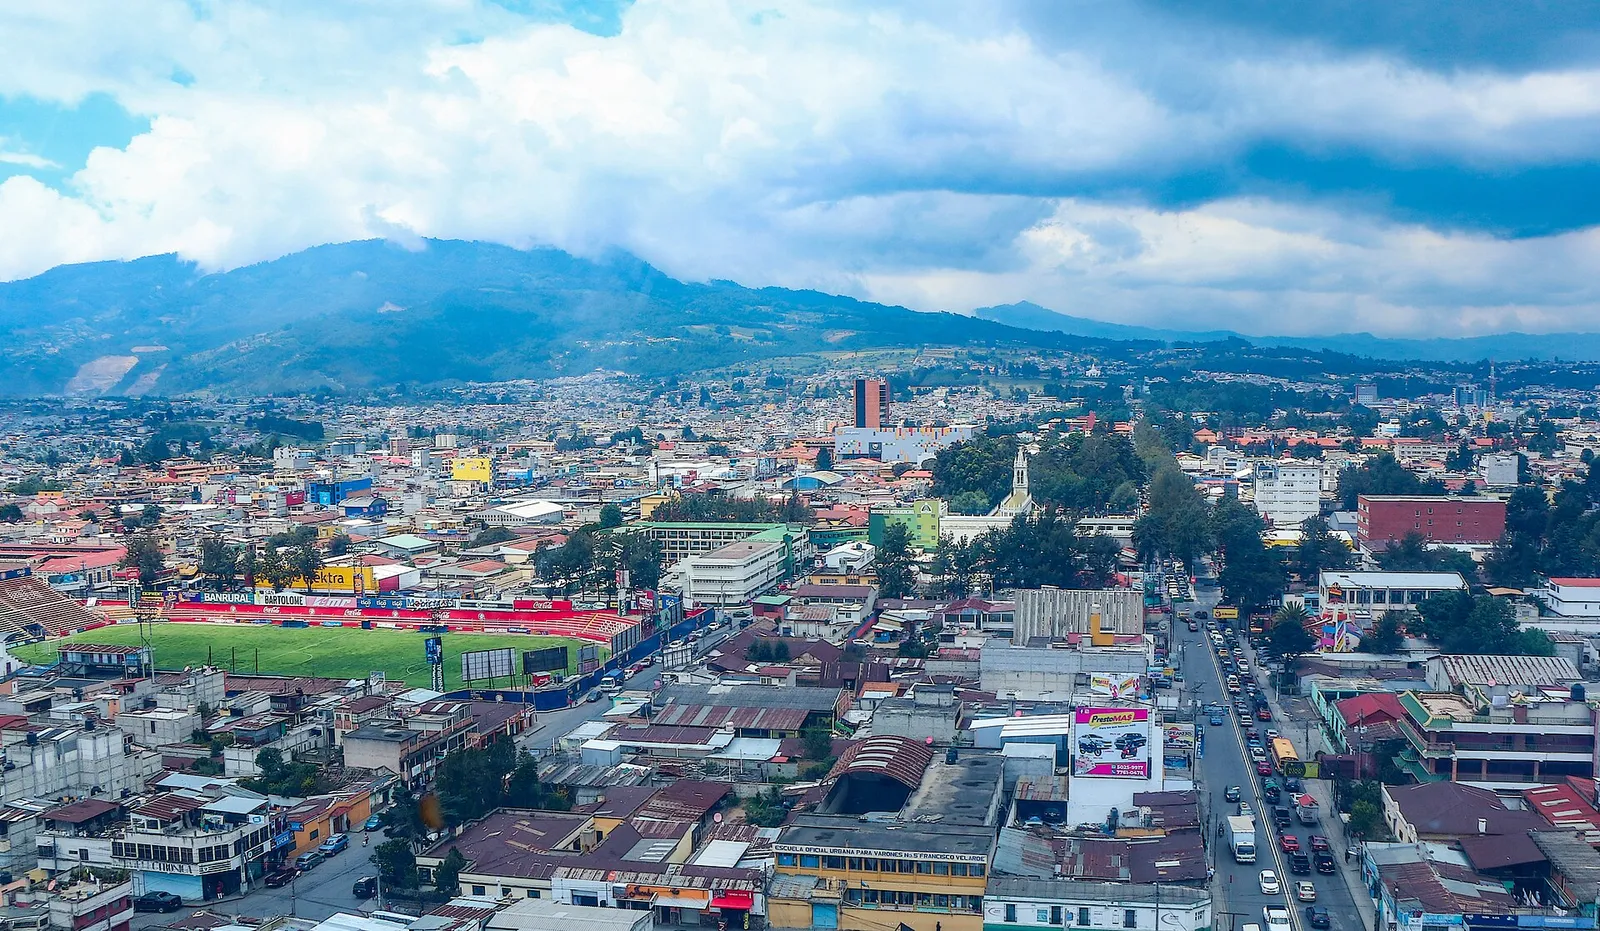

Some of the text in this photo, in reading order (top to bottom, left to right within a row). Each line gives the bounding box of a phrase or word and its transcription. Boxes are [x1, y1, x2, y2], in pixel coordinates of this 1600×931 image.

[204, 592, 251, 602] BANRURAL
[264, 595, 303, 605] BARTOLOME
[1091, 714, 1133, 723] PrestoMAS
